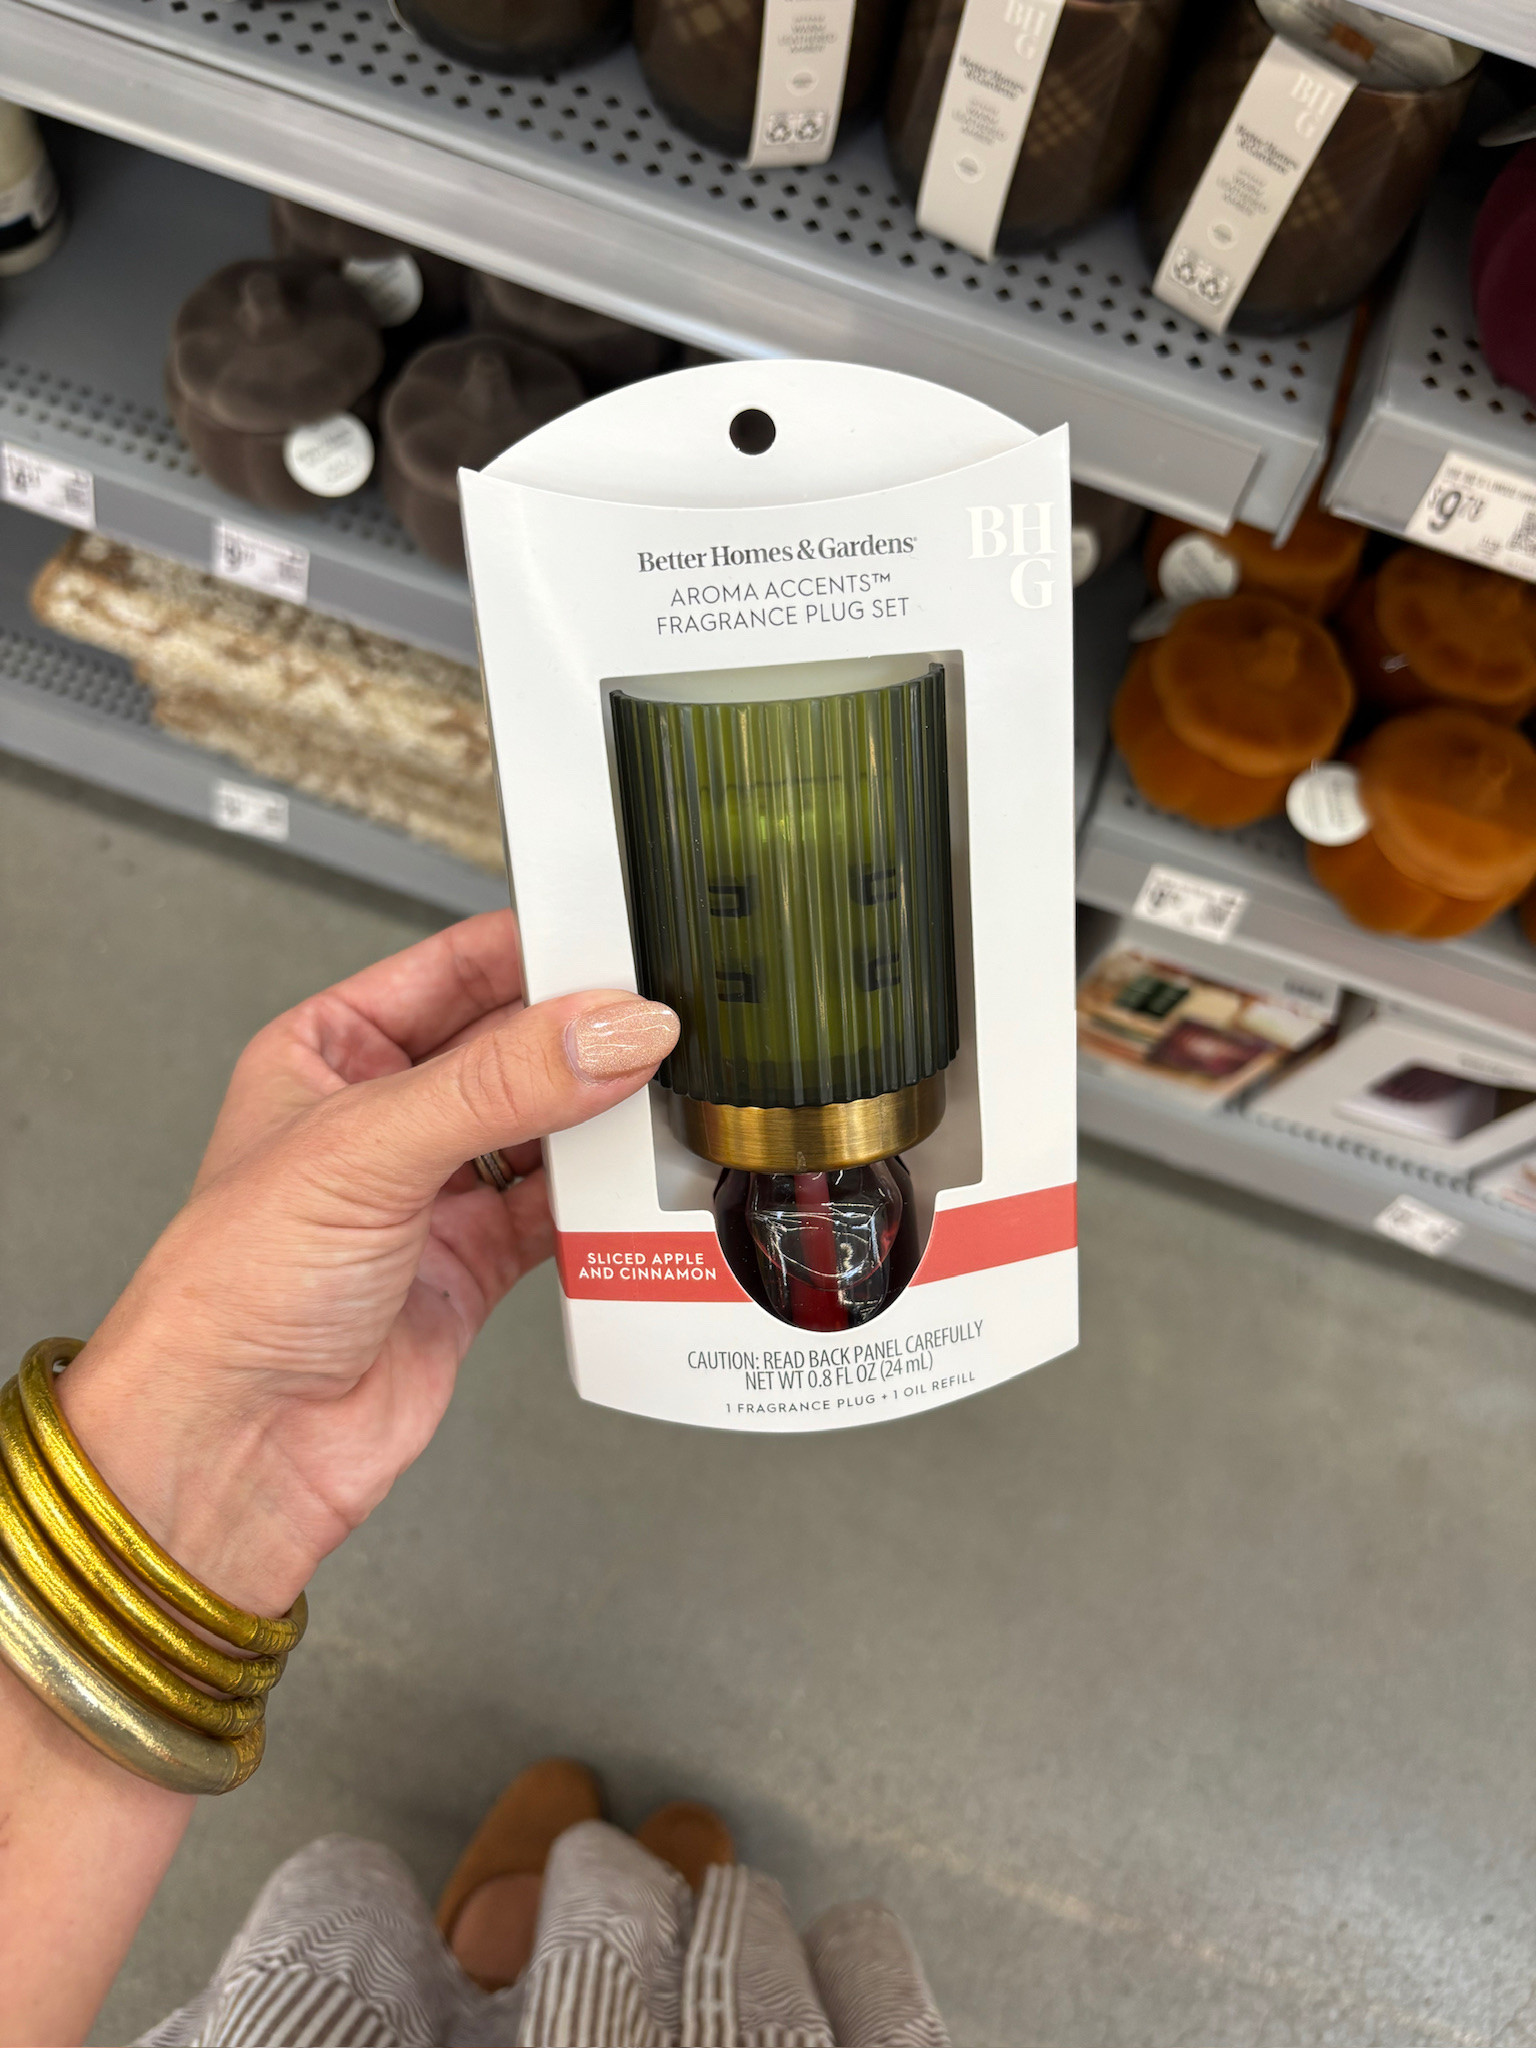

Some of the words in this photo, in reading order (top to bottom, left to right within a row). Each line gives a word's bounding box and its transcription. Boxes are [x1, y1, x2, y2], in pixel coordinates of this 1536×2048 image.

[637, 551, 707, 572] Better
[710, 545, 793, 567] Homes
[797, 538, 817, 560] &
[671, 582, 759, 606] AROMA
[657, 606, 798, 635] FRAGRANCE
[806, 600, 864, 623] PLUG
[872, 597, 909, 618] SET
[578, 1266, 614, 1280] AND
[619, 1267, 717, 1281] CINNAMON
[587, 1252, 646, 1265] SLICED
[651, 1253, 705, 1265] APPLE
[688, 1350, 760, 1370] CAUTION:
[763, 1350, 805, 1369] READ
[809, 1347, 851, 1368] BACK
[854, 1339, 903, 1363] PANEL
[905, 1319, 983, 1354] CAREFULLY
[745, 1371, 774, 1390] NET
[777, 1370, 804, 1389] WT
[808, 1368, 833, 1388] 0.8
[836, 1366, 854, 1386] FL
[856, 1362, 877, 1383] OZ
[880, 1358, 903, 1381] (24
[905, 1350, 933, 1373] mL)
[726, 1403, 731, 1413] 1
[737, 1400, 831, 1414] FRAGRANCE
[837, 1394, 876, 1408] PLUG
[903, 1384, 927, 1397] OIL
[931, 1371, 976, 1391] REFILL
